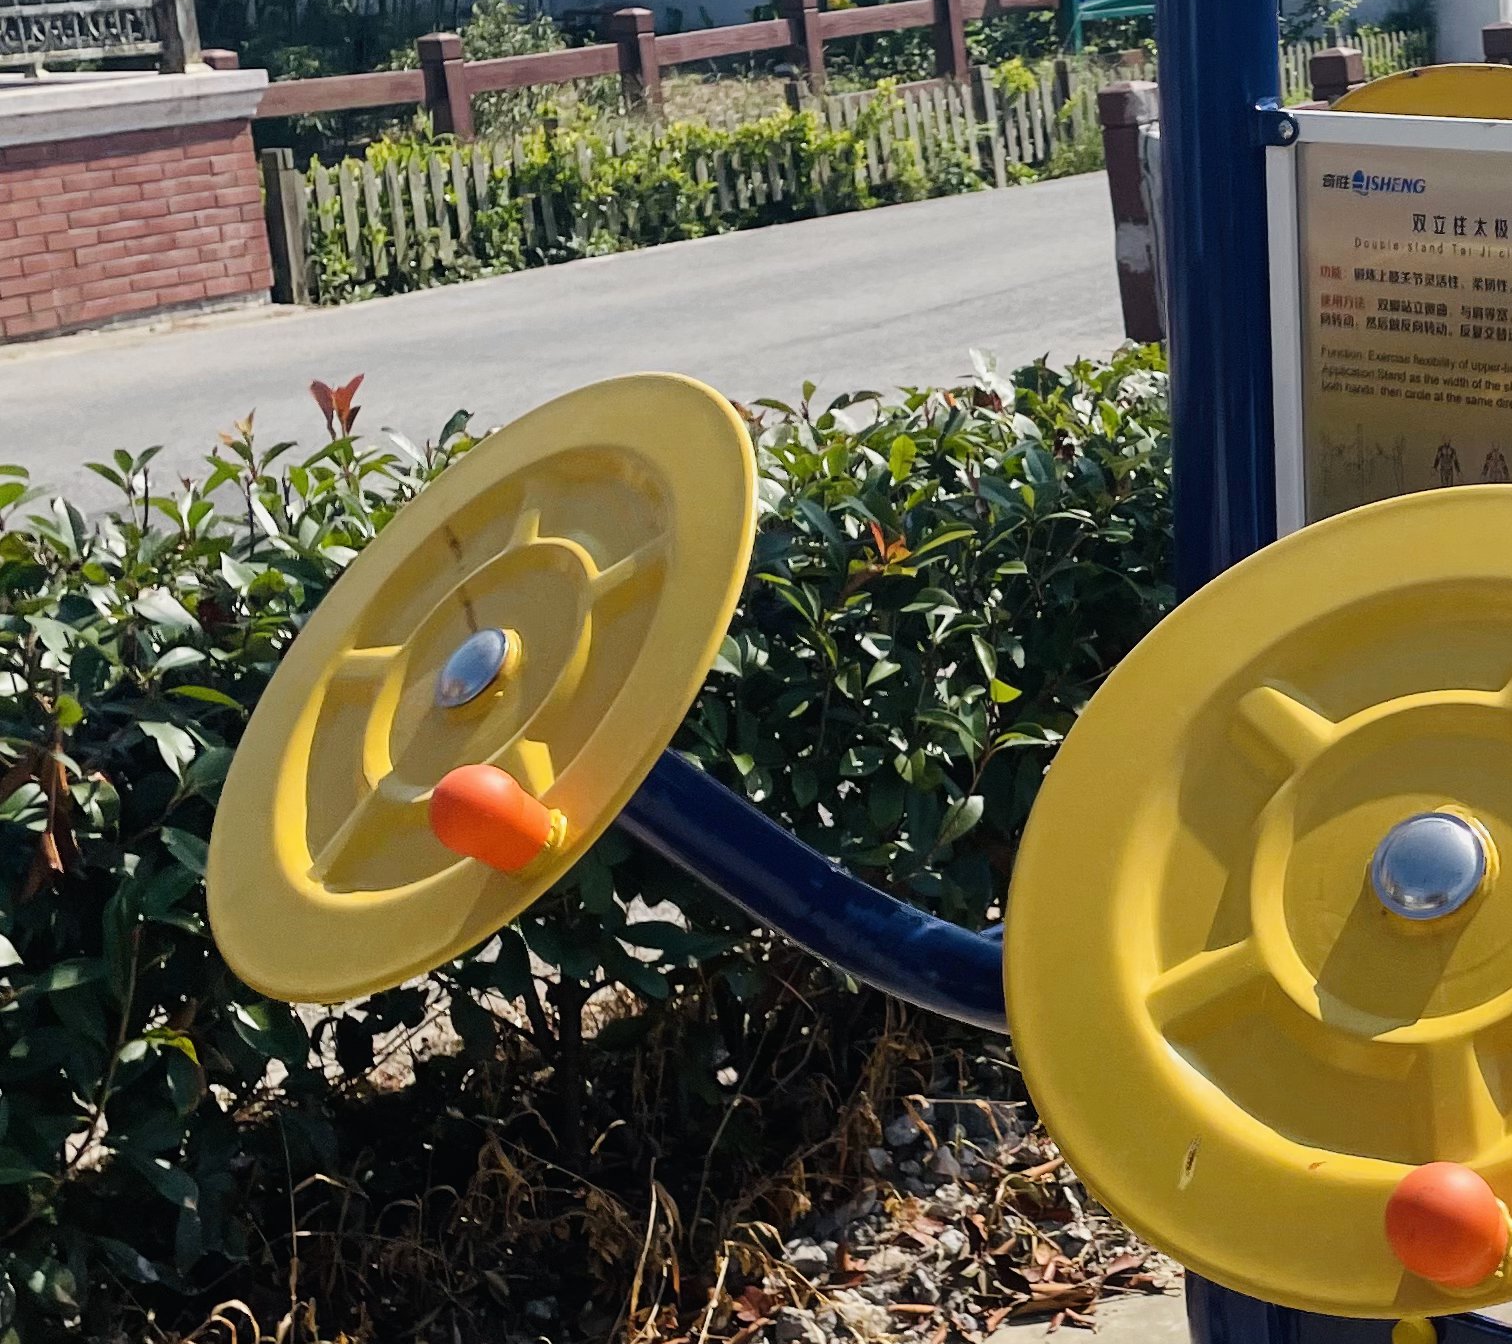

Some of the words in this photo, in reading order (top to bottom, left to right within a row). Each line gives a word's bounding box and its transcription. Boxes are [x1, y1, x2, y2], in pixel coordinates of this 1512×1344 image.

[1354, 237, 1400, 252] Double
[1458, 358, 1469, 370] of
[1409, 374, 1421, 383] as
[1424, 373, 1440, 385] the
[1442, 375, 1469, 388] width
[1472, 378, 1482, 389] of
[1485, 380, 1501, 391] the
[1380, 385, 1402, 397] then
[1433, 392, 1443, 402] at
[1446, 392, 1462, 403] the
[1465, 395, 1494, 407] same
